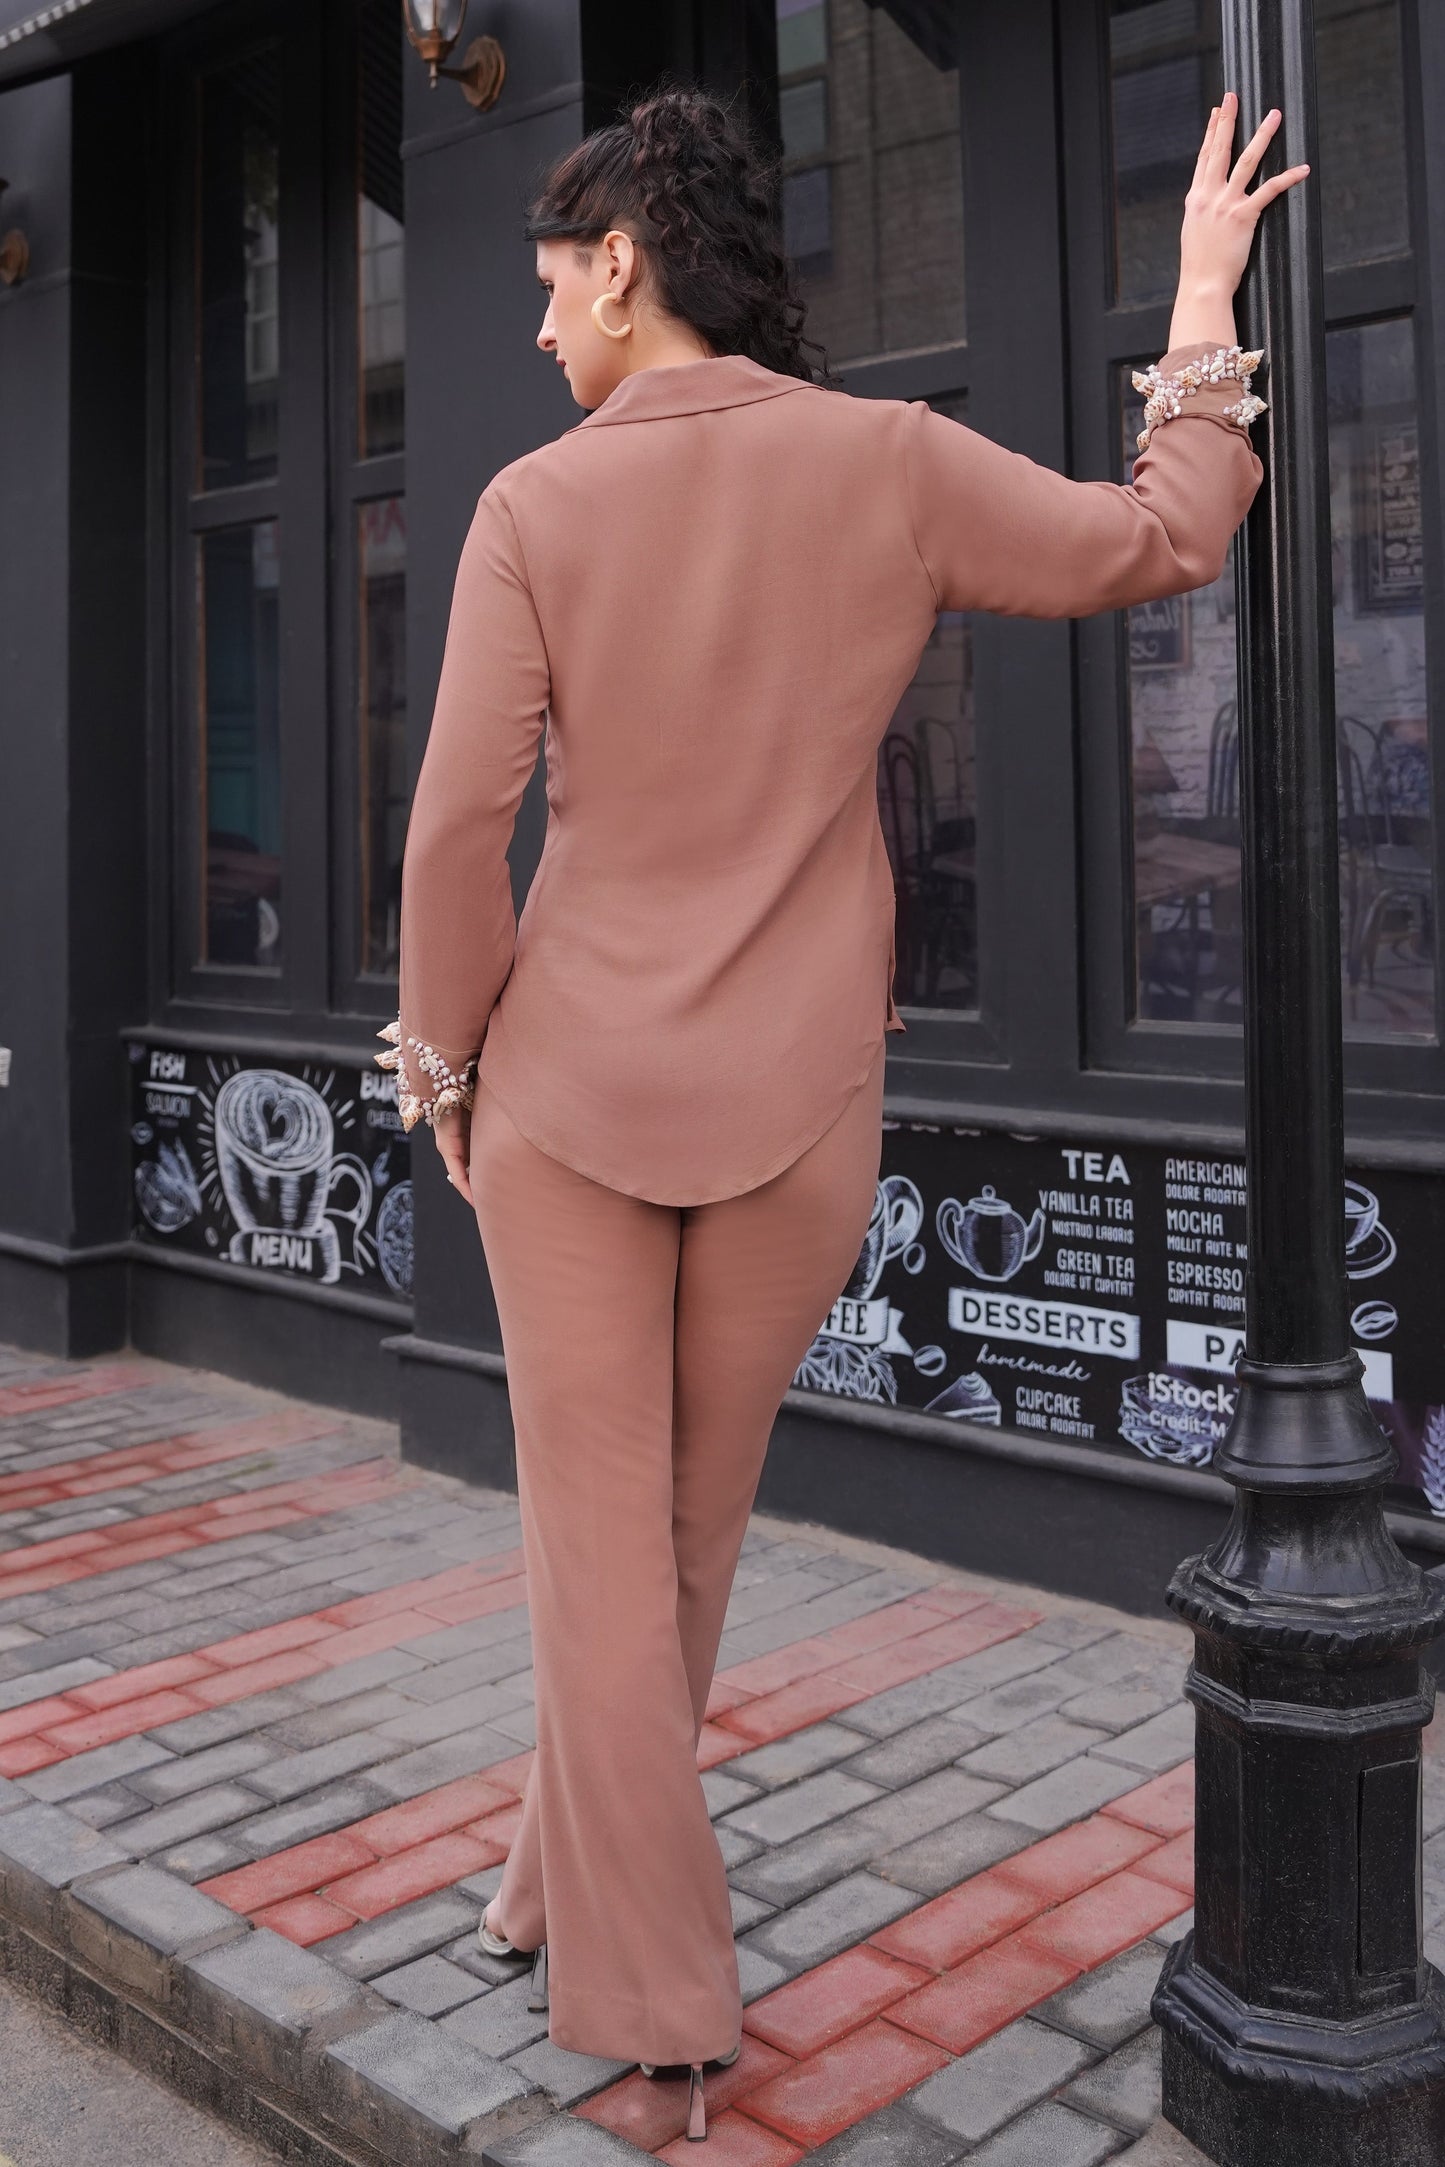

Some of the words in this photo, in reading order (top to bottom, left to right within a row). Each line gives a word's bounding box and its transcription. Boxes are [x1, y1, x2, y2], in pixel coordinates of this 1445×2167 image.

[150, 1051, 186, 1080] FISH
[1061, 1149, 1131, 1186] TEA
[1165, 1158, 1247, 1188] AMERICAN
[1038, 1189, 1101, 1217] VANILLA
[1104, 1196, 1134, 1221] TEA
[1165, 1183, 1201, 1202] DOLORE
[1096, 1224, 1134, 1245] LABORIS
[1166, 1208, 1224, 1236] MOCHA
[251, 1232, 313, 1272] MENU
[1167, 1235, 1202, 1254] MOLLIT
[1205, 1240, 1234, 1258] AUTE
[1057, 1248, 1102, 1275] GREEN
[1106, 1255, 1135, 1280] TEA
[1167, 1260, 1243, 1293] ESPRESSO
[1044, 1269, 1077, 1289] DOLORE
[1079, 1275, 1092, 1291] UT
[962, 1297, 1127, 1348] DESSERTS
[976, 1343, 1091, 1381] homemade
[1016, 1386, 1081, 1418] CUPCAKE
[1016, 1410, 1048, 1431] DOLORE
